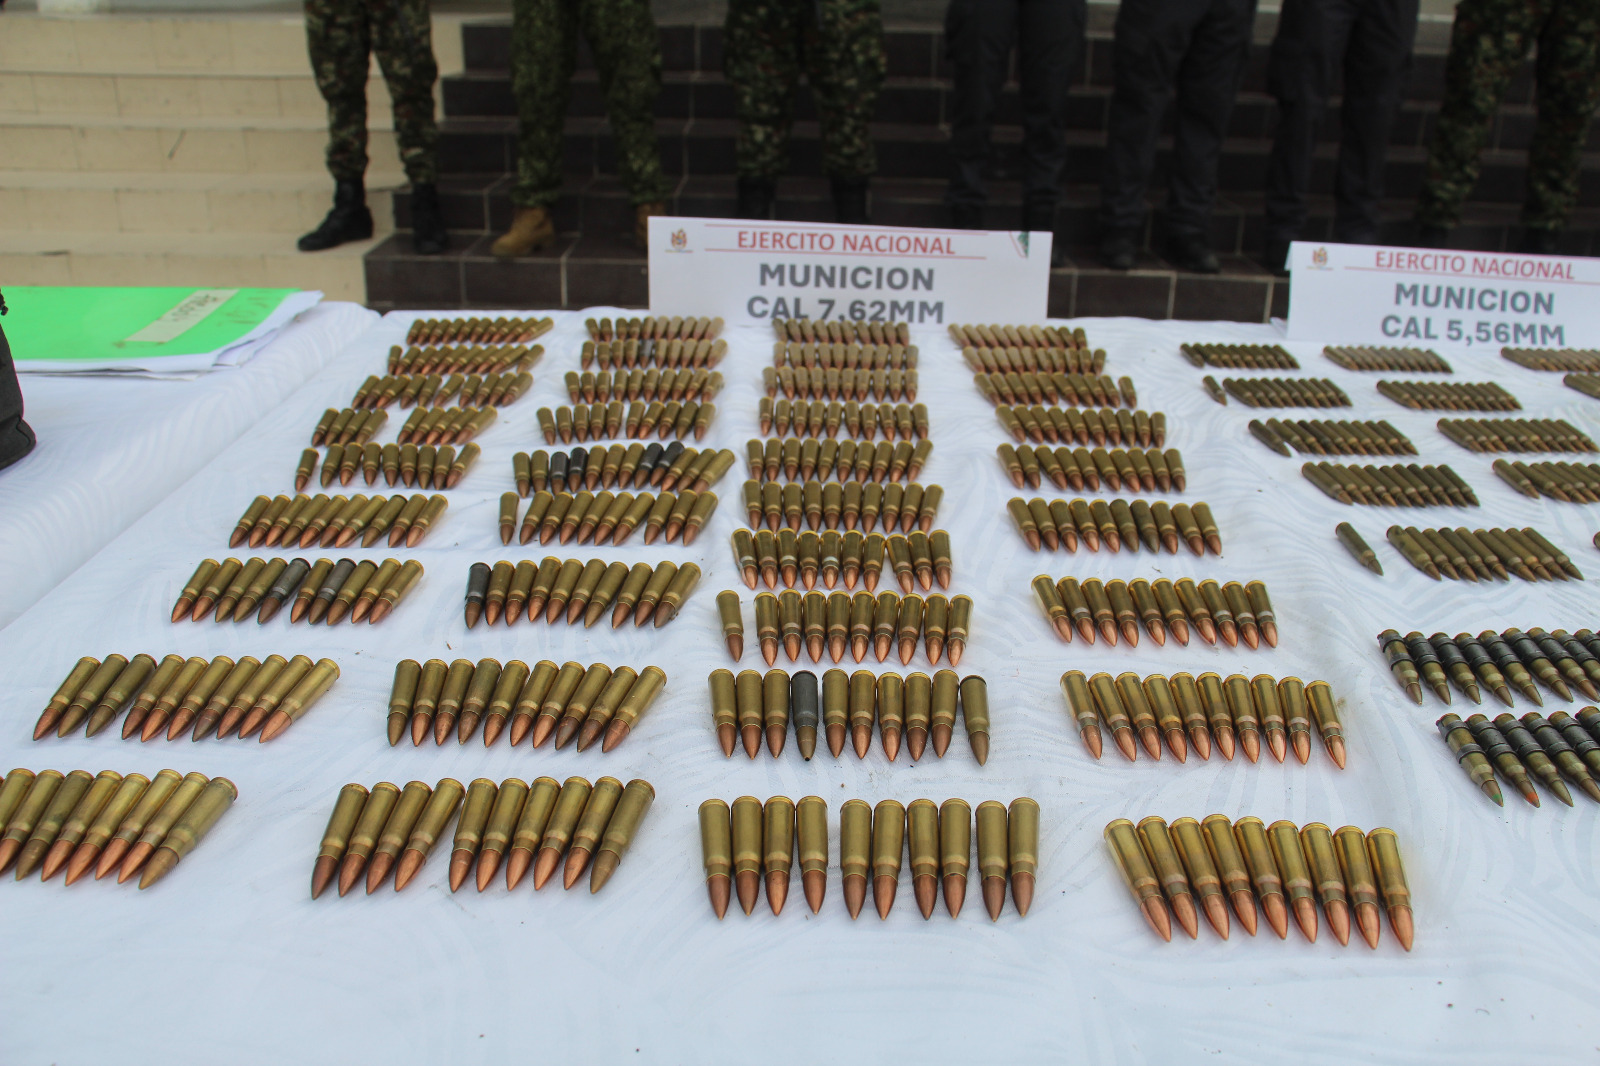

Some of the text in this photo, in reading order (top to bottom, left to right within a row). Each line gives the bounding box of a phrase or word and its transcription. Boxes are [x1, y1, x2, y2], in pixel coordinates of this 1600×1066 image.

[737, 231, 955, 256] EJERCITO NACIONAL
[759, 263, 935, 291] MUNICION
[1375, 250, 1575, 280] EJERCITO NACIONAL
[747, 296, 808, 320] CAL
[1394, 282, 1555, 315] MUNICION
[1381, 315, 1565, 346] CAL 5,56MM
